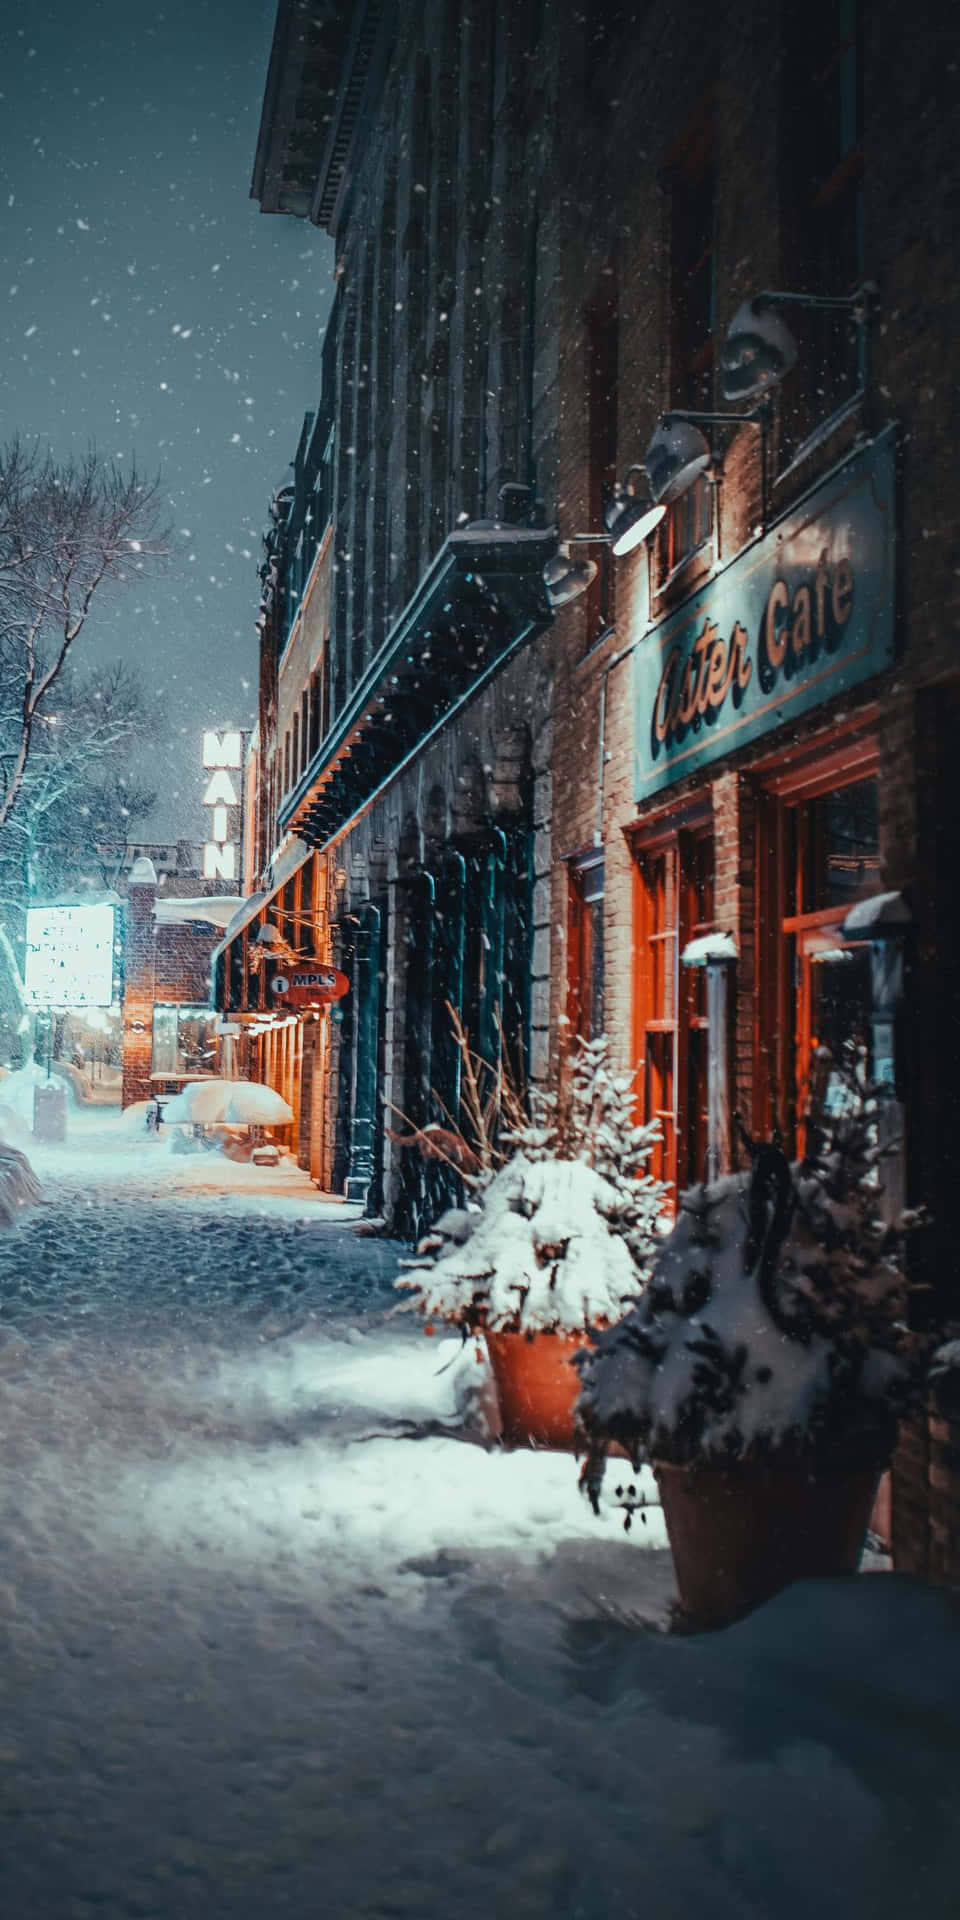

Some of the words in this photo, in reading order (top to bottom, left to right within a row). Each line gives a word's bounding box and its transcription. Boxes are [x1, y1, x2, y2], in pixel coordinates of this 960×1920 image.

[654, 617, 751, 742] Aster
[764, 547, 854, 668] Cafe
[203, 731, 242, 880] MAIN
[293, 974, 335, 986] MPLS
